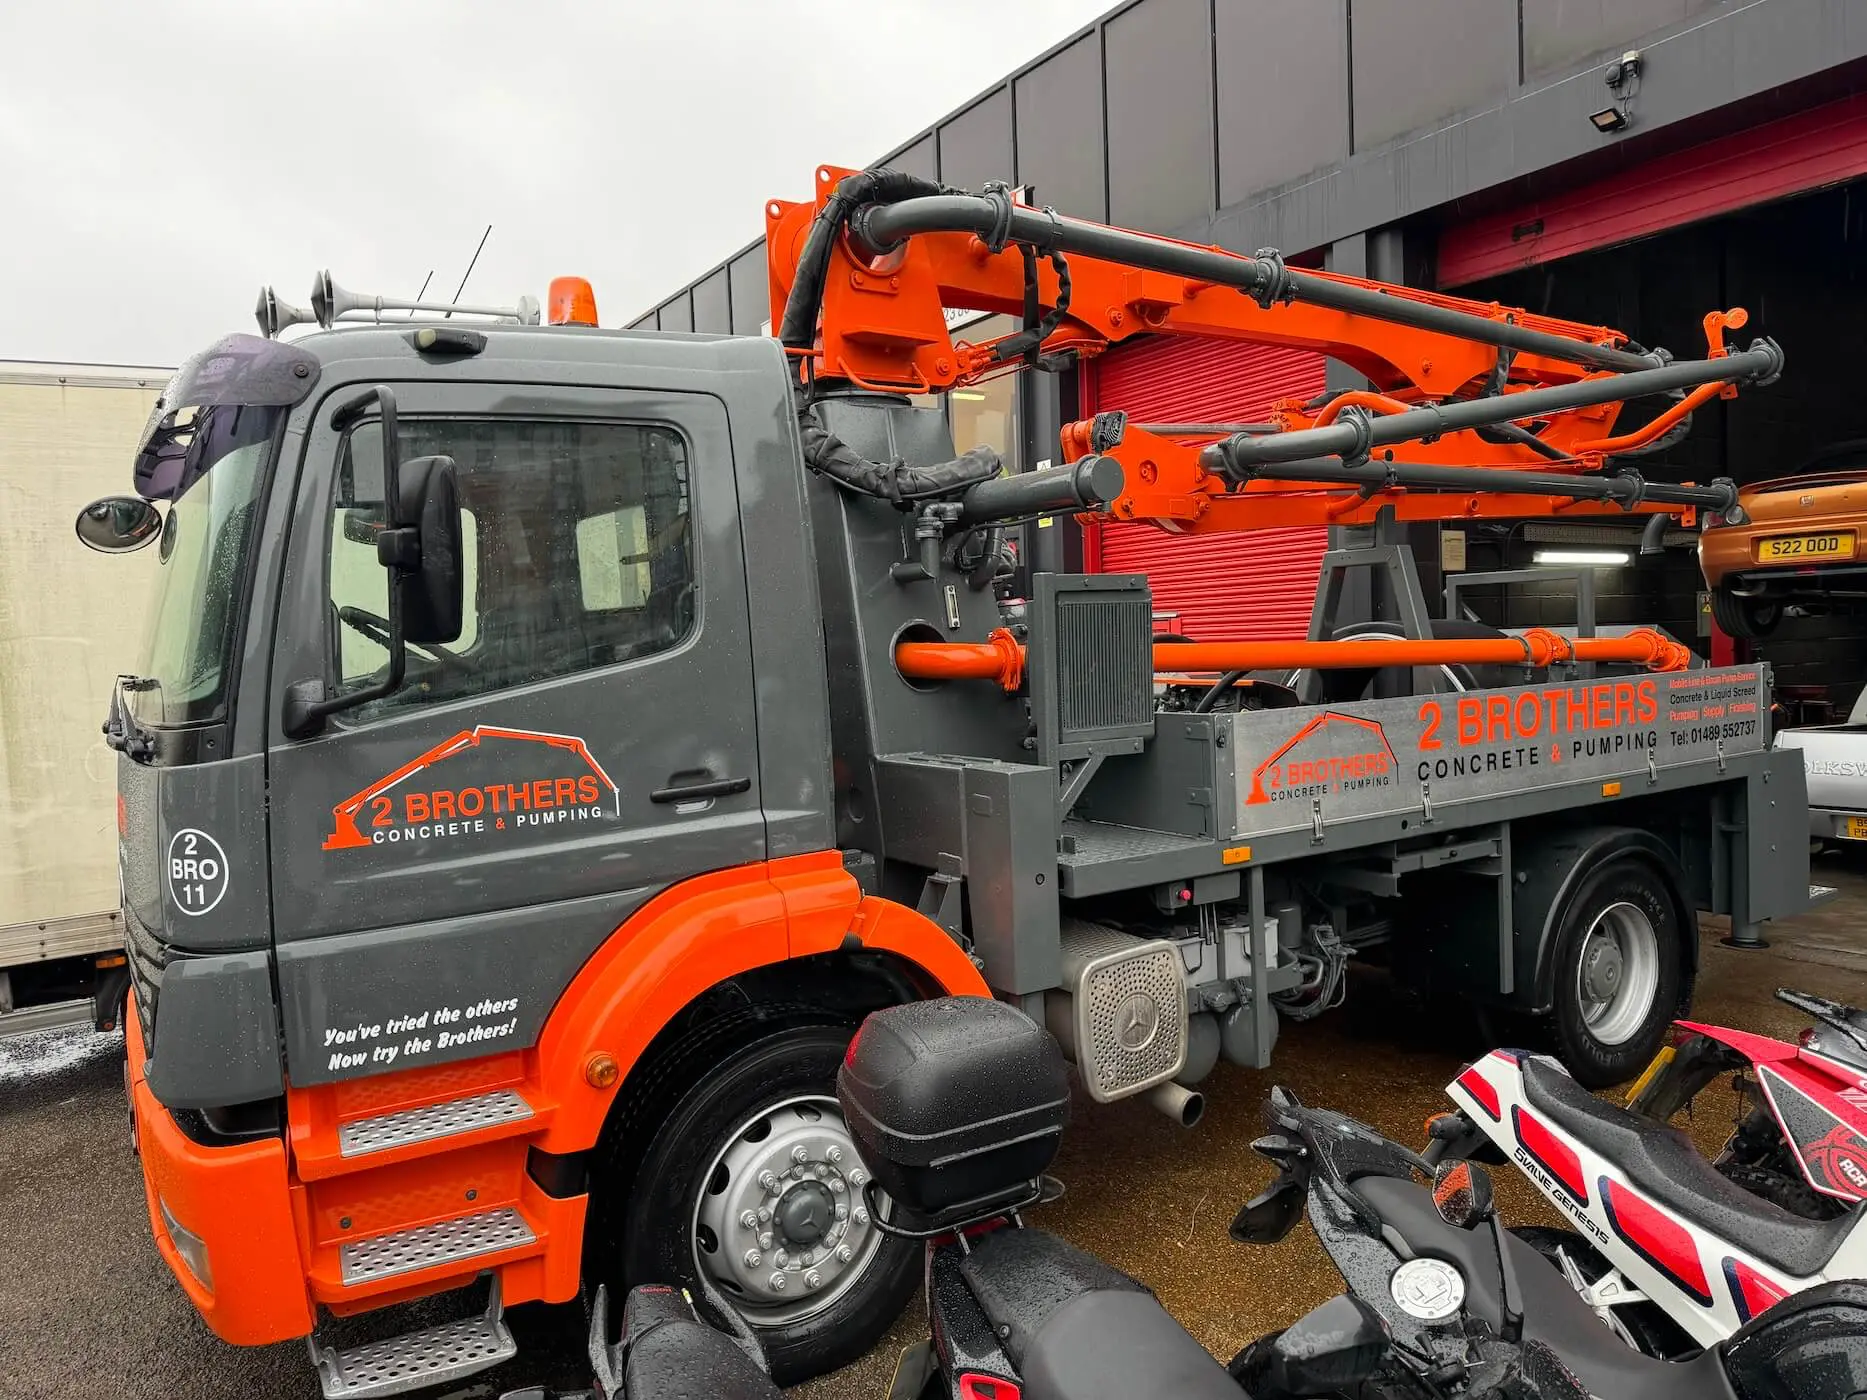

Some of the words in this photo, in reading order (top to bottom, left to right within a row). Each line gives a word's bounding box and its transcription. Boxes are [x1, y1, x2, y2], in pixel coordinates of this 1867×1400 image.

[1772, 540, 1802, 555] S22
[1670, 692, 1702, 704] Concrete
[1703, 690, 1709, 700] &
[1711, 688, 1732, 701] Liquid
[1733, 685, 1756, 696] Screed
[1417, 701, 1442, 750] 2
[1457, 680, 1658, 746] BROTHERS
[1669, 709, 1698, 722] Pumping
[1703, 705, 1725, 718] Supply
[1670, 731, 1689, 746] Tel:
[1691, 725, 1720, 743] 01489
[1722, 720, 1756, 739] 552737
[1270, 765, 1281, 788] 2
[1287, 751, 1389, 785] BROTHERS
[1418, 747, 1539, 781] CONCRETE
[1551, 743, 1561, 763] &
[1573, 731, 1657, 759] PUMPING
[371, 797, 393, 827] 2
[406, 775, 600, 824] BROTHERS
[1271, 784, 1328, 801] CONCRETE
[1344, 776, 1389, 791] PUMPING
[373, 820, 485, 844] CONCRETE
[495, 817, 506, 831] &
[516, 806, 601, 827] PUMPING
[184, 834, 198, 855] 2
[172, 858, 219, 881] BRO
[183, 884, 205, 905] 11
[324, 1023, 382, 1047] You've
[386, 1011, 429, 1035] tried
[433, 1006, 461, 1026] the
[465, 997, 519, 1019] others
[327, 1052, 368, 1071] Now
[372, 1045, 399, 1065] try
[403, 1037, 432, 1056] the
[436, 1017, 518, 1049] Brothers!
[1552, 1189, 1610, 1245] GENESIS
